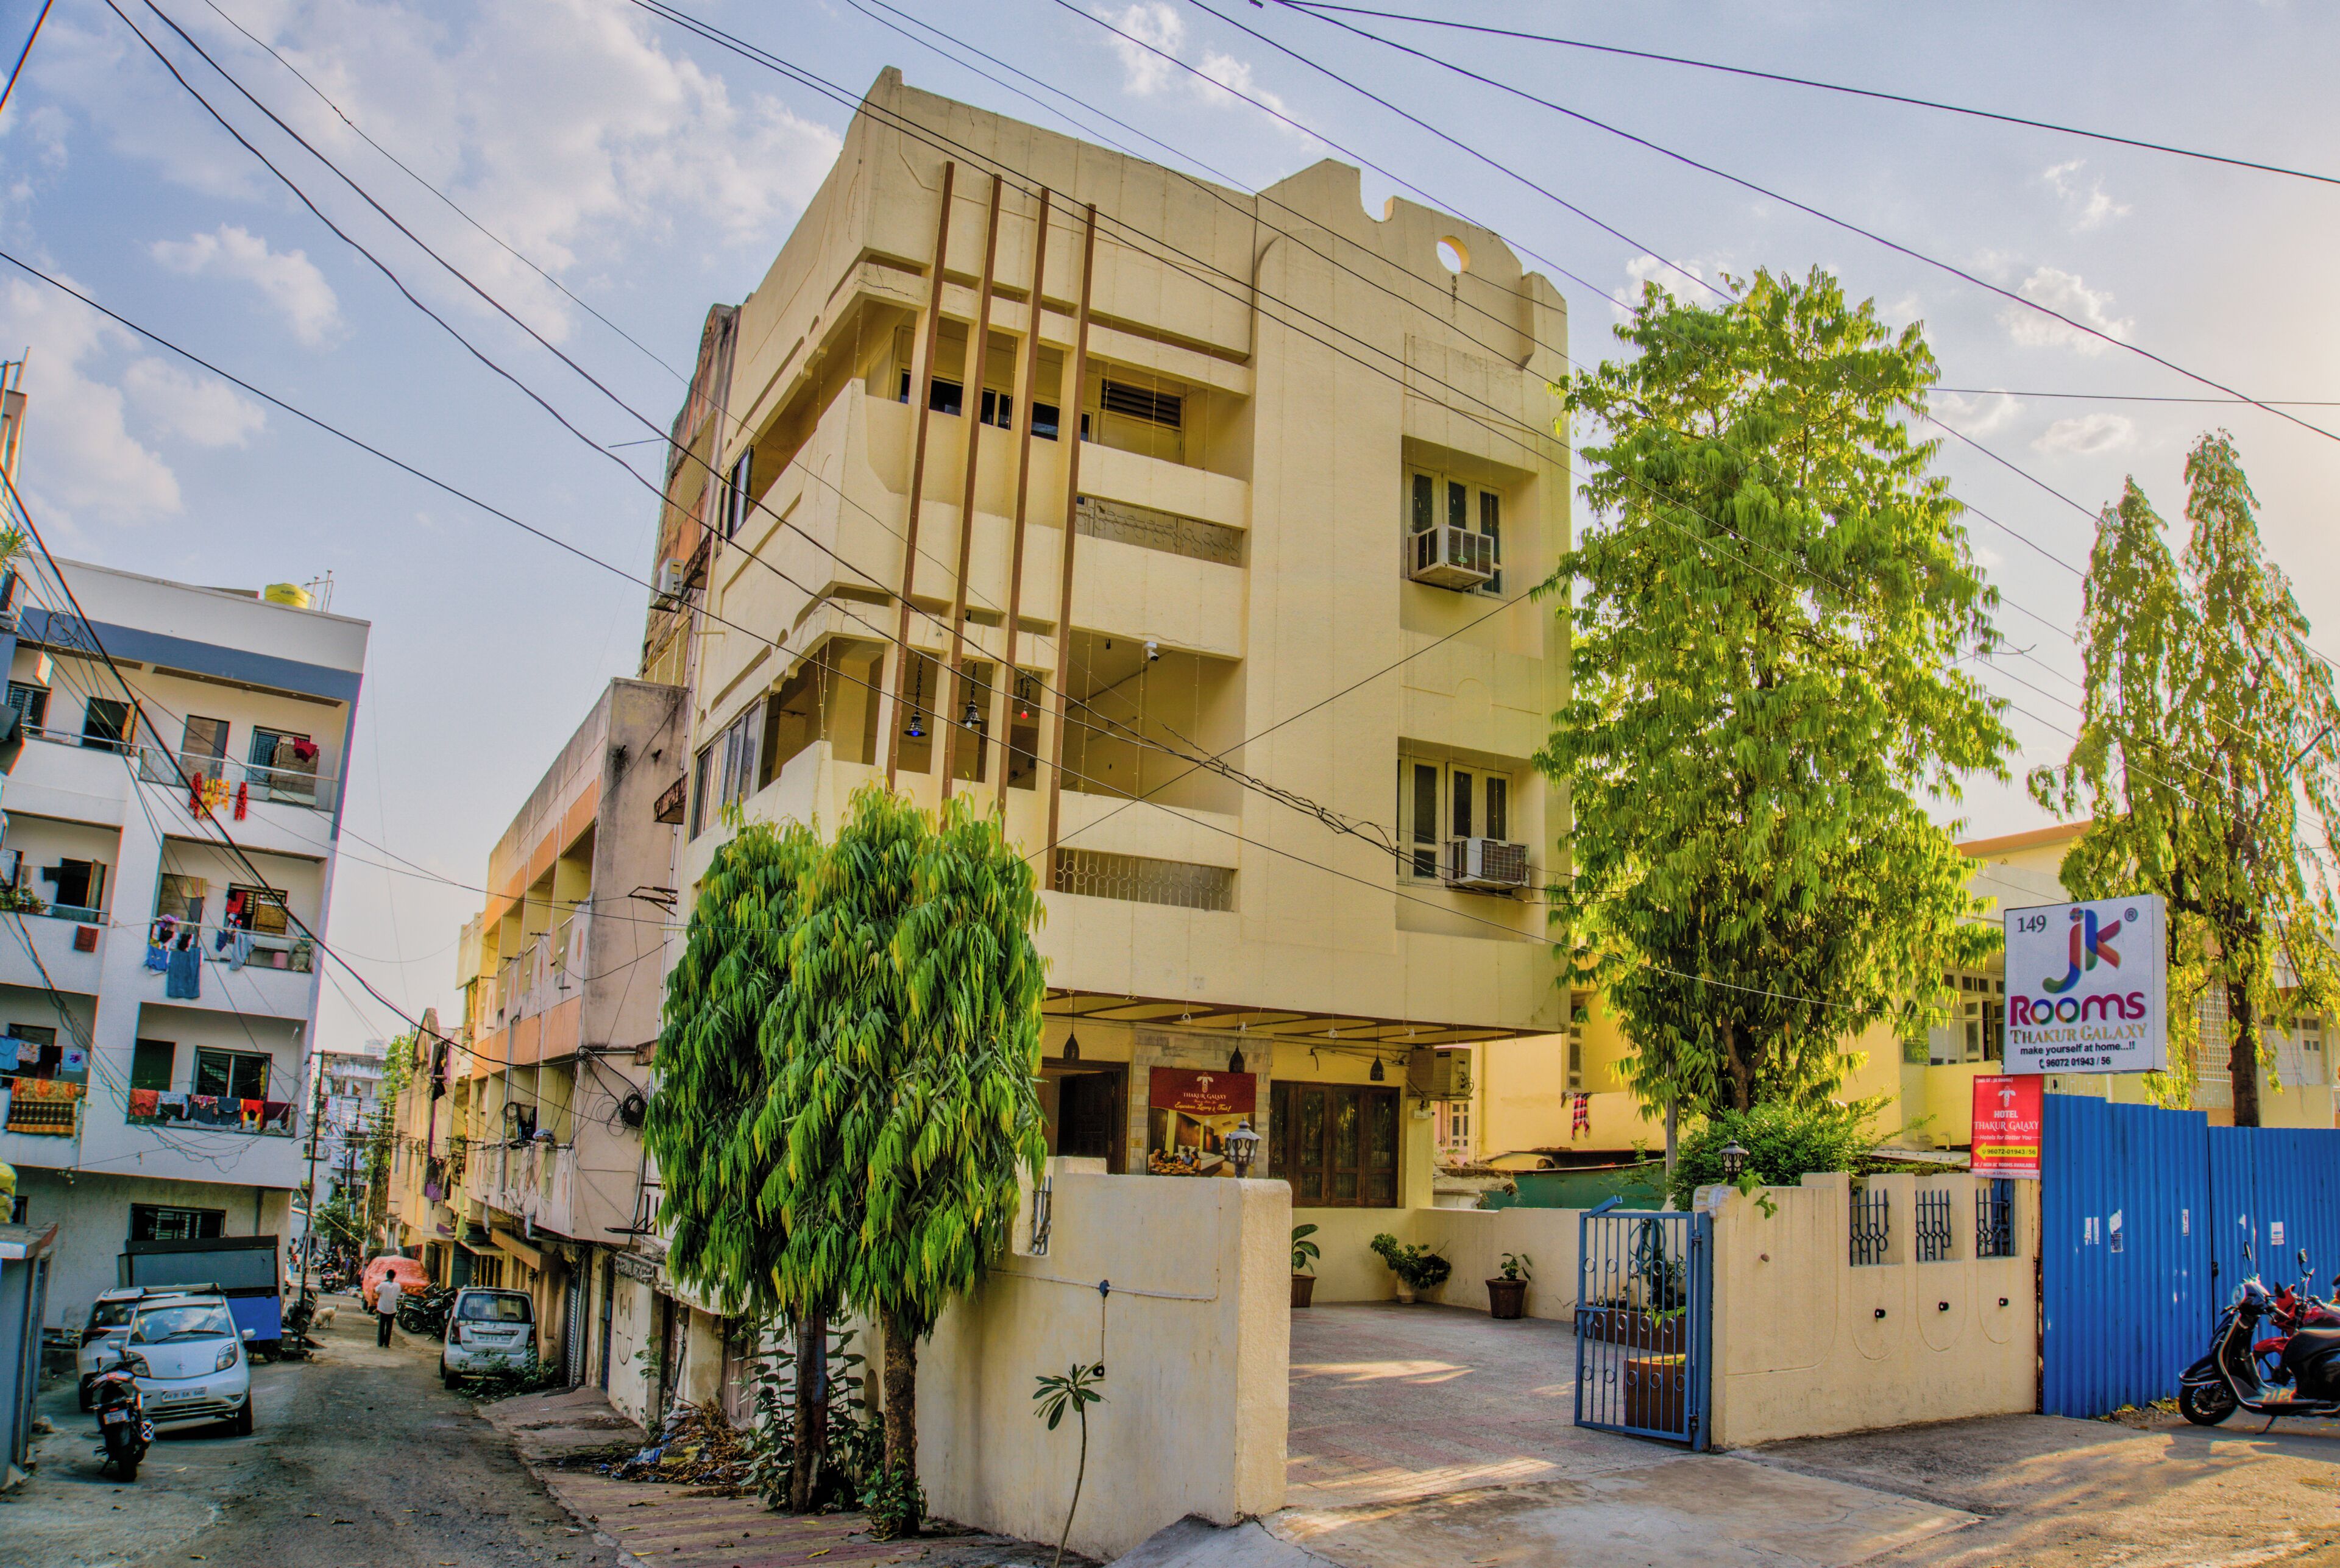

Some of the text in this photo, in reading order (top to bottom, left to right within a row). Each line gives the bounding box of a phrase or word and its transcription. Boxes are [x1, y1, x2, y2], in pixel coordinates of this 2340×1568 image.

[2018, 915, 2047, 933] 149
[2010, 1022, 2147, 1044] THAKUR GALAXY
[2020, 1046, 2043, 1055] make
[2046, 1043, 2081, 1055] yourself
[2095, 1041, 2135, 1052] home...!!
[2046, 1059, 2069, 1067] 96072
[2071, 1057, 2094, 1066] 01943
[2101, 1056, 2111, 1065] 56
[1974, 1121, 2039, 1132] THAKUR GALAXY
